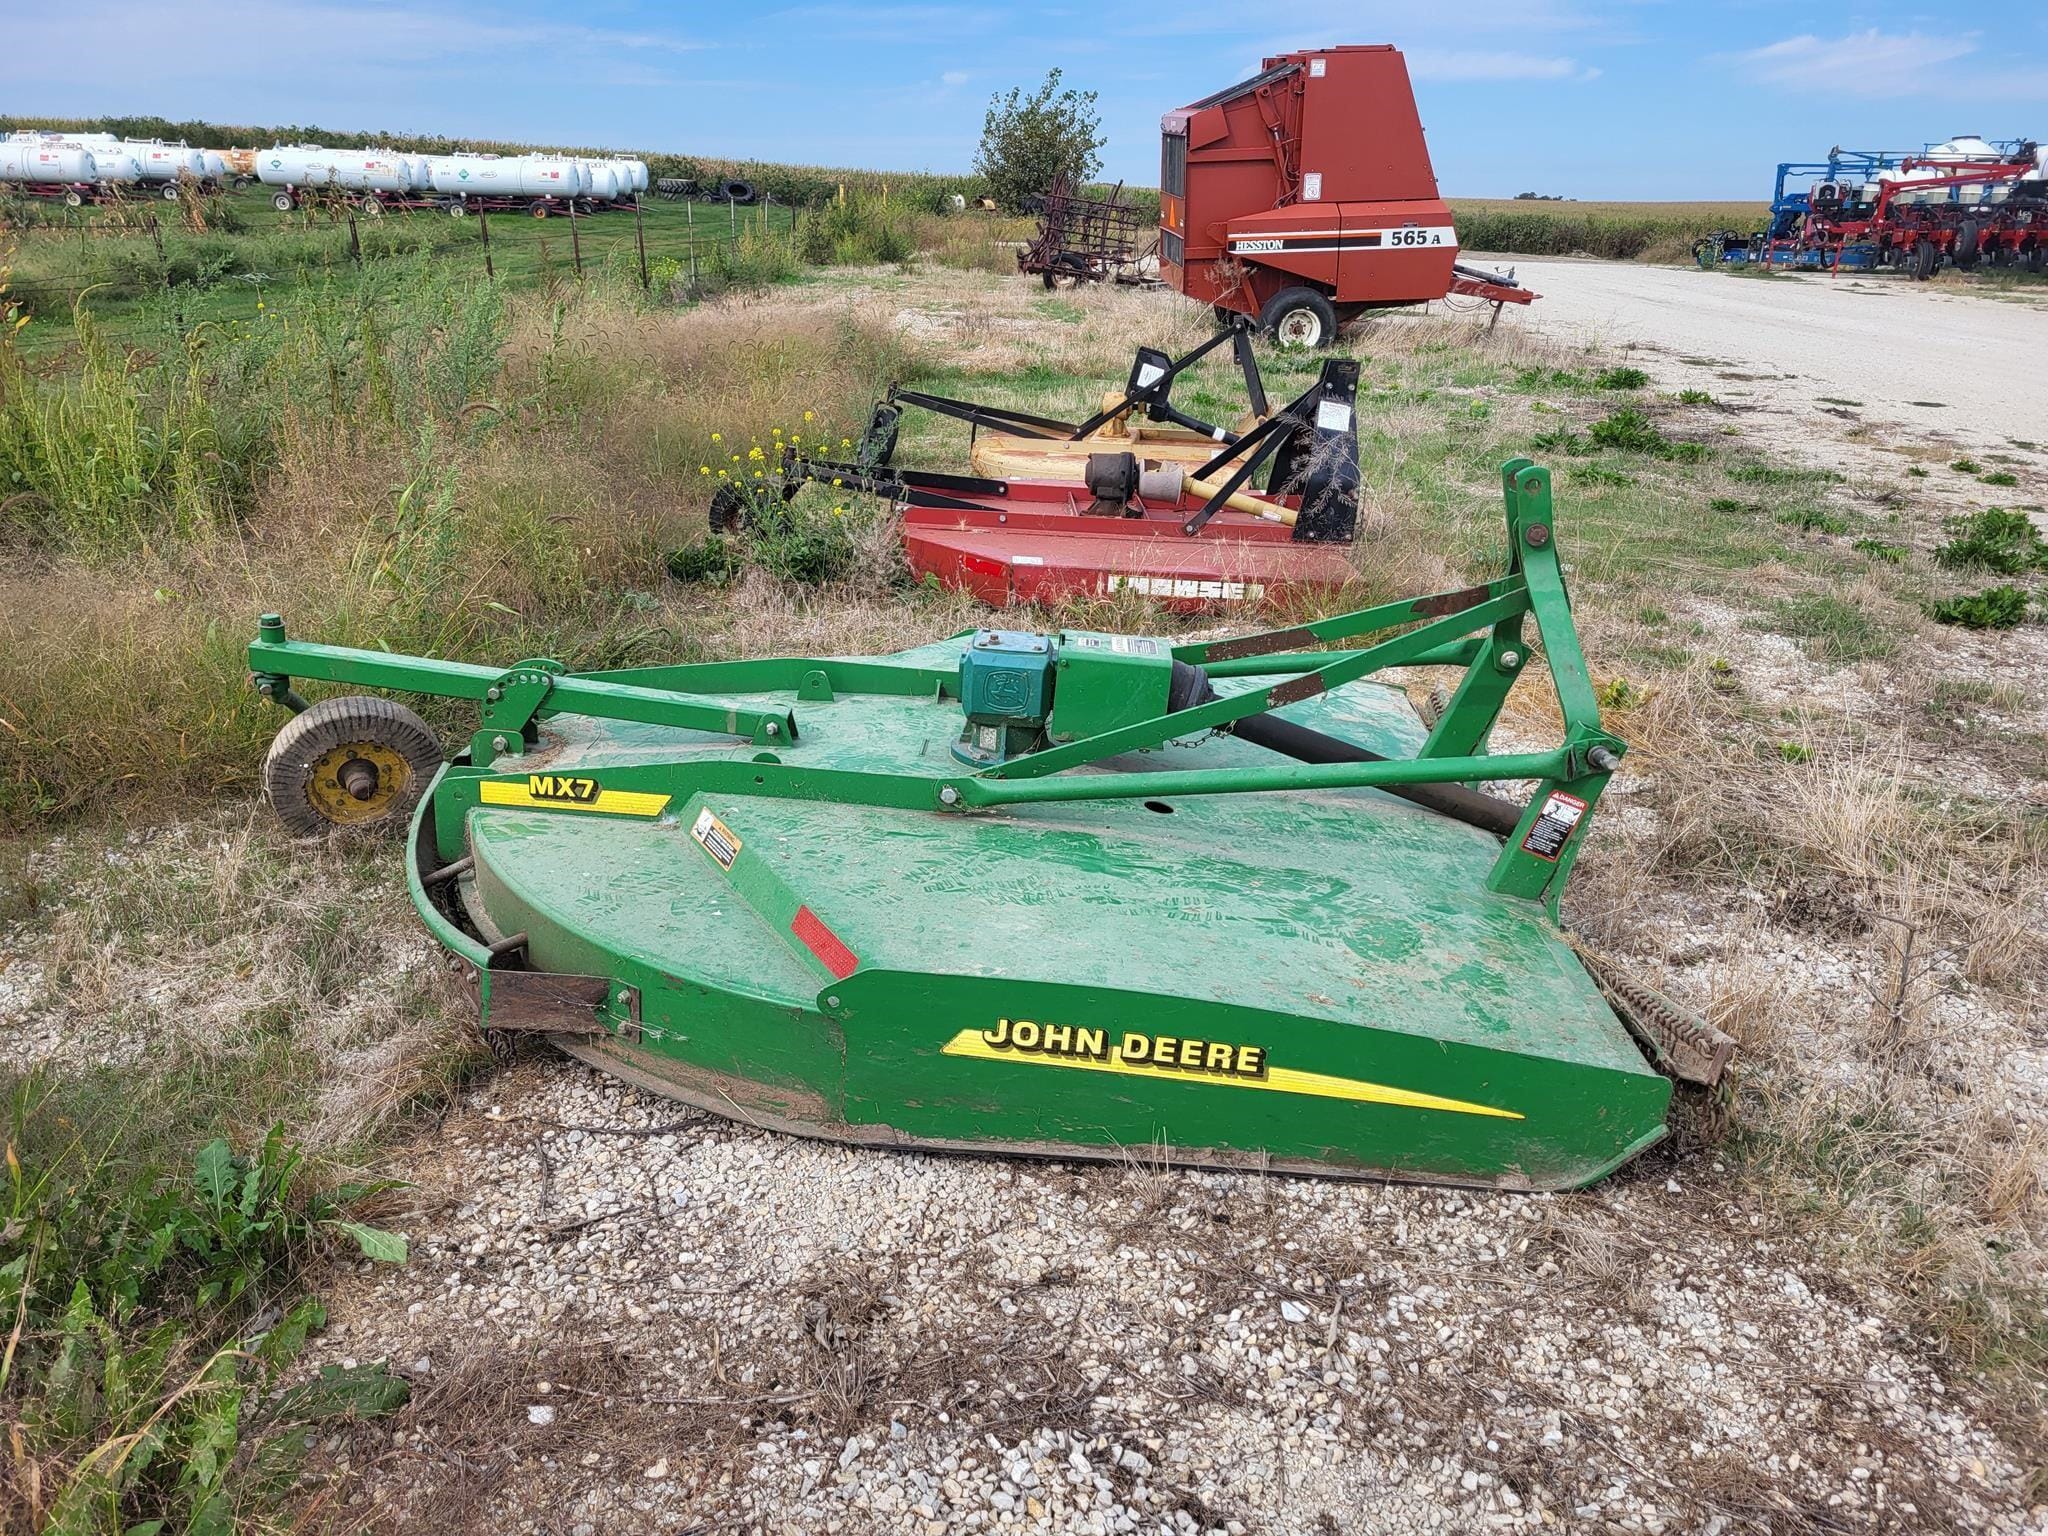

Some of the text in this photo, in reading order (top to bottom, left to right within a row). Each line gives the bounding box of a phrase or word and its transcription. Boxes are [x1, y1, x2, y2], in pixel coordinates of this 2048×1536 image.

[1235, 239, 1284, 251] HESSTON
[1391, 230, 1441, 246] 565 A
[529, 775, 596, 799] MX7
[1559, 793, 1585, 809] DANGER
[983, 1018, 1263, 1074] JOHN DEERE
